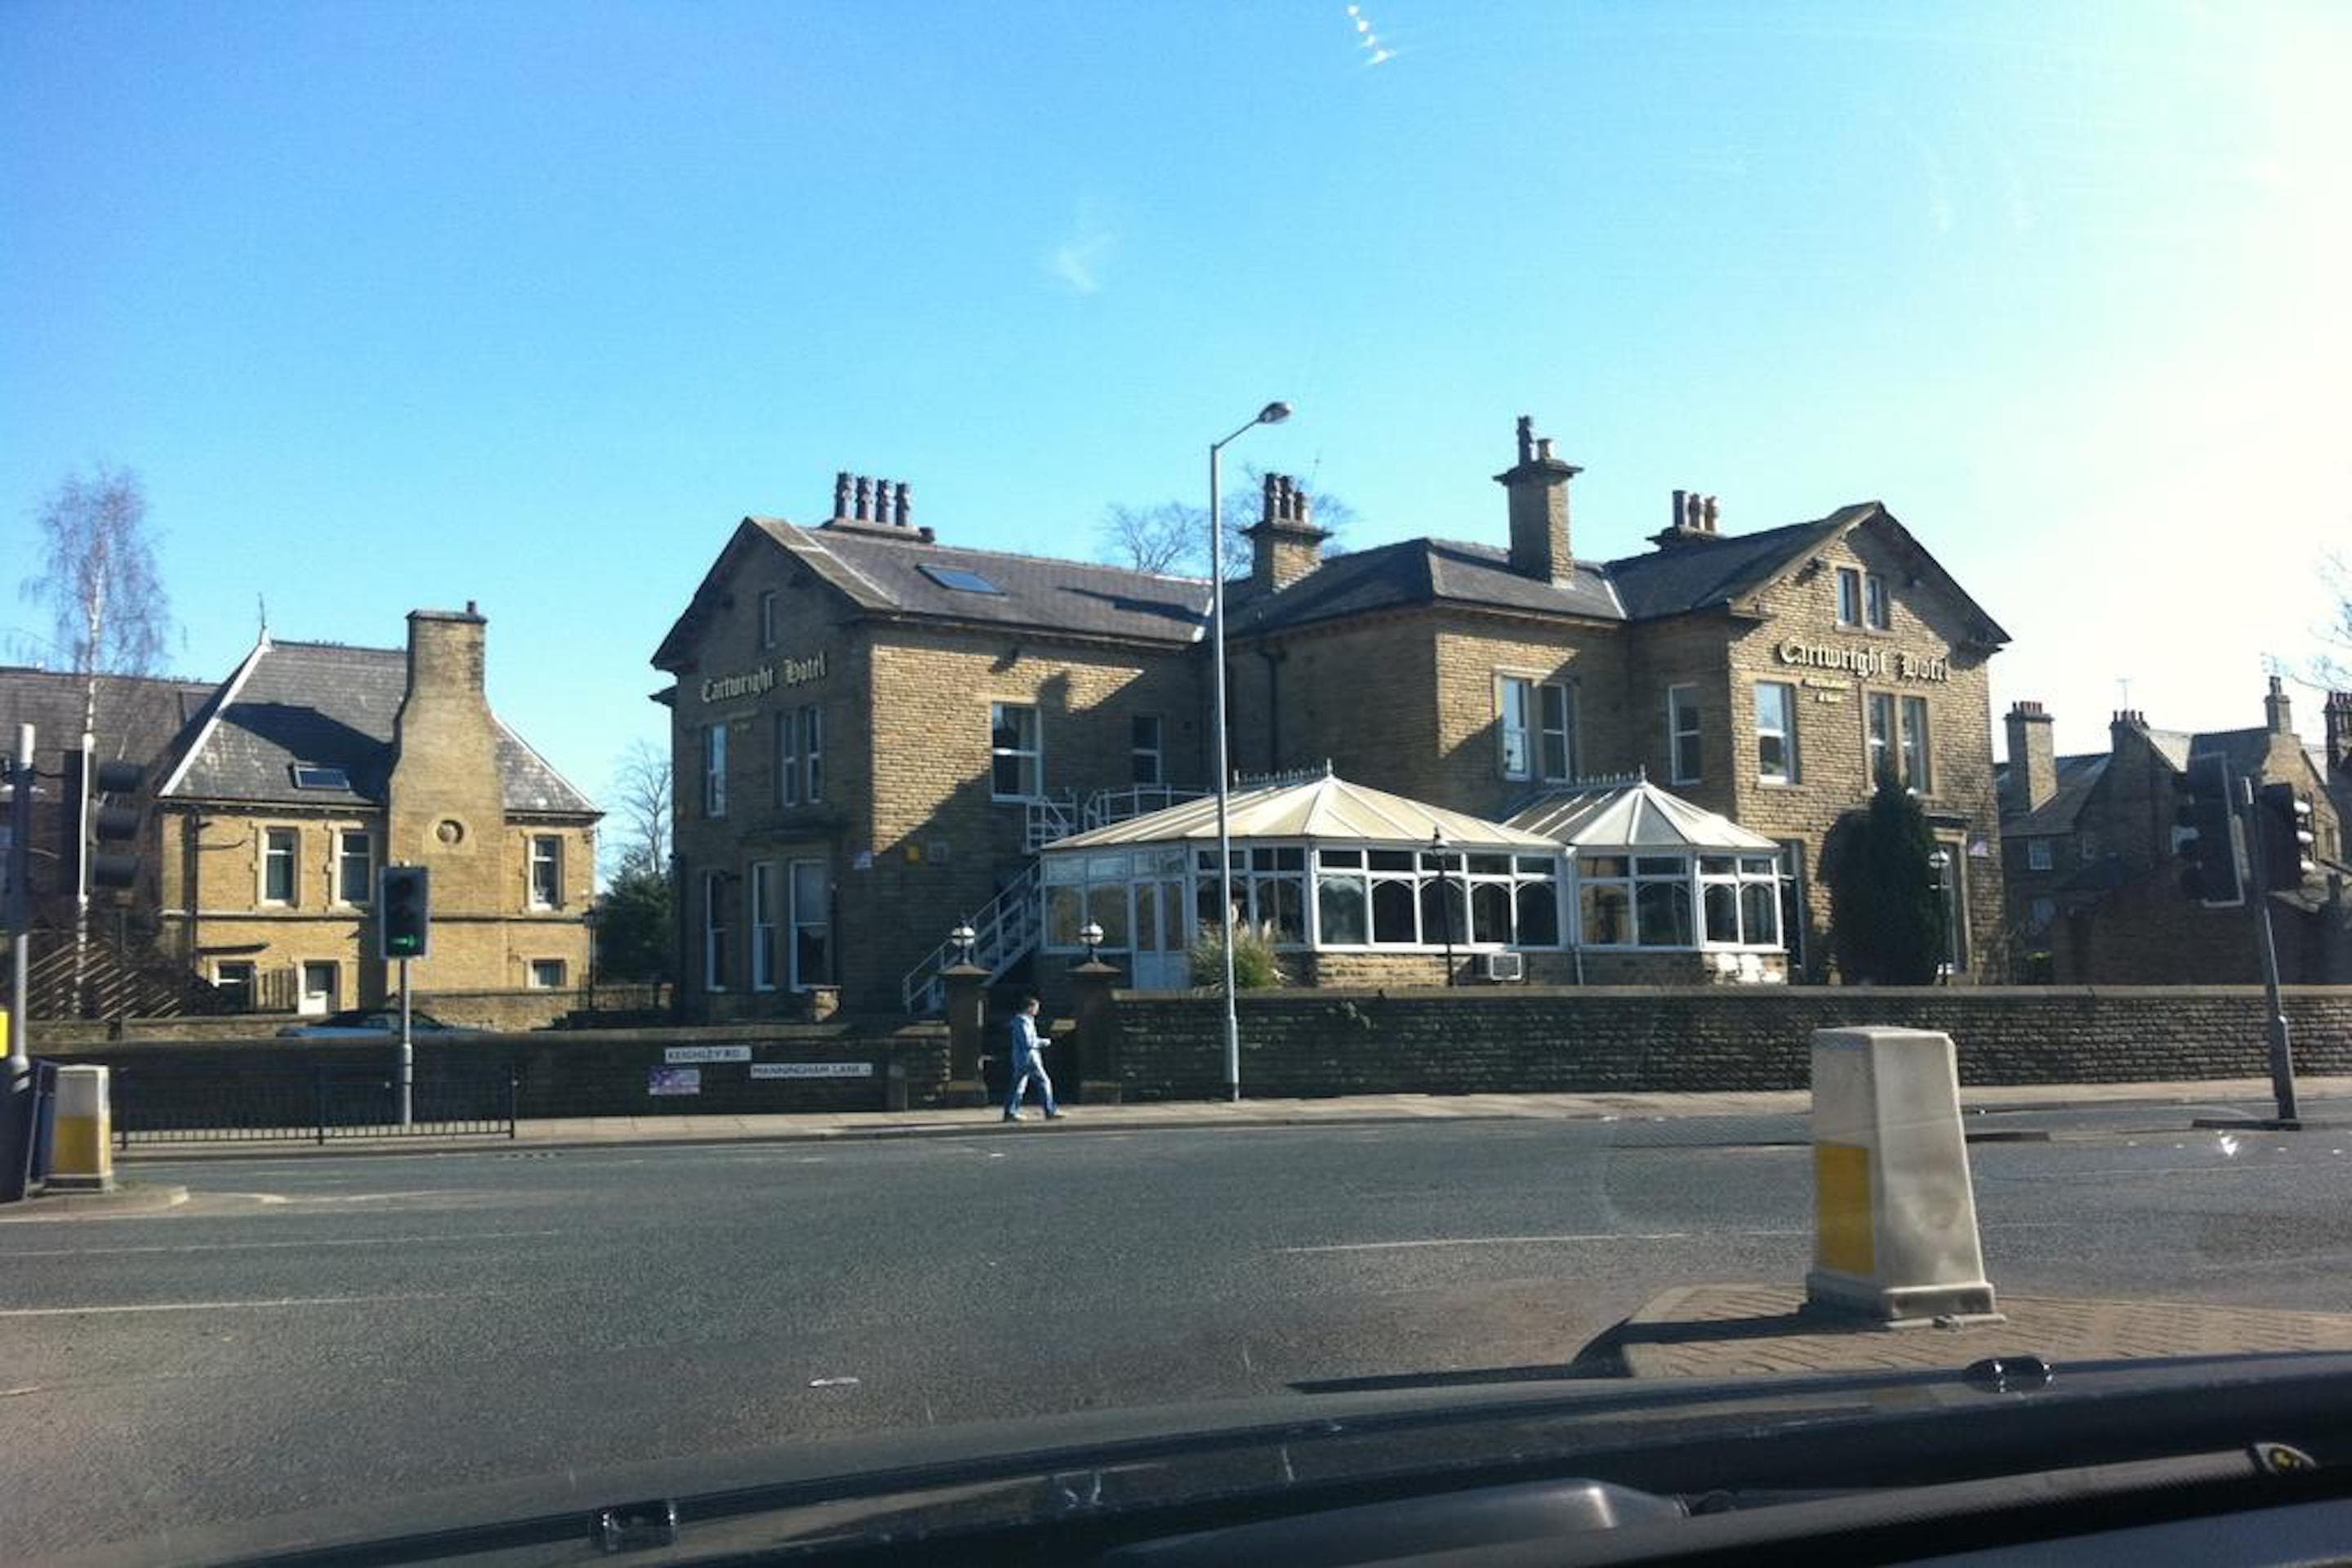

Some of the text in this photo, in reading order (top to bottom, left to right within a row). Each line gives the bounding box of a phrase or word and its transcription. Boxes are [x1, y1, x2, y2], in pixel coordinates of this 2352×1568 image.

[1778, 639, 1950, 683] Cartwright Hotel
[702, 651, 826, 703] Cartwright Hotel
[668, 1049, 722, 1061] KEIGHLEY
[752, 1065, 829, 1075] MANNINGHAM
[831, 1065, 860, 1073] LANE
